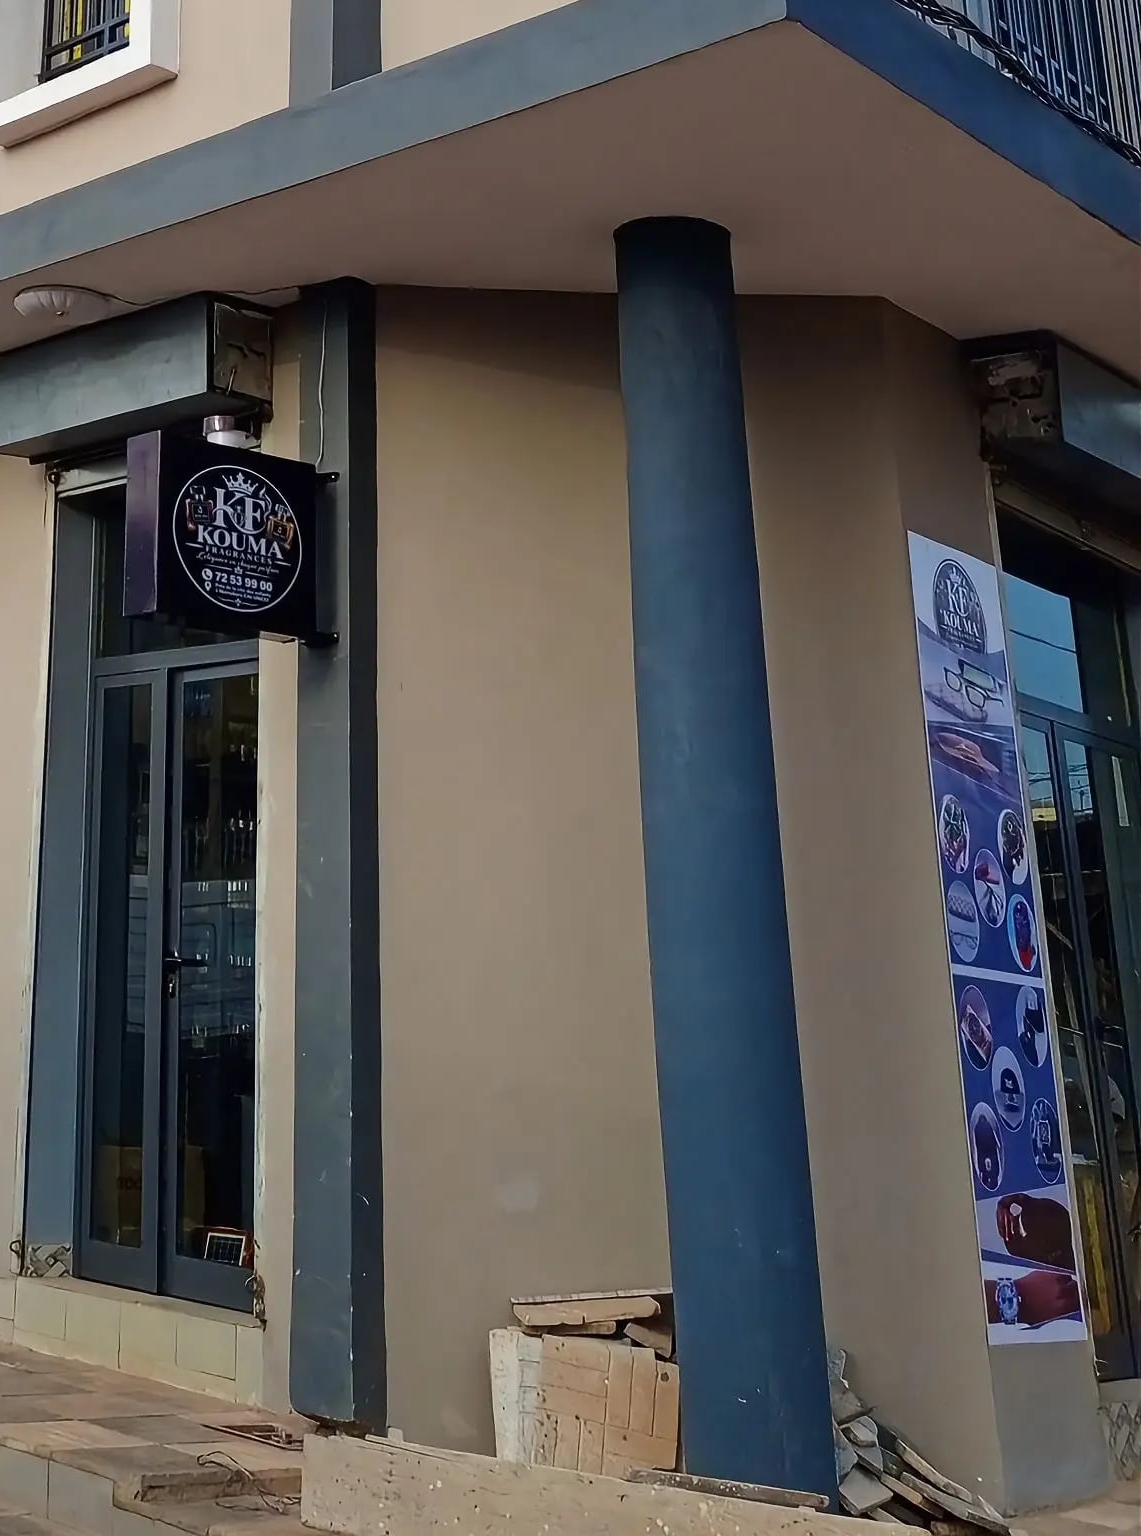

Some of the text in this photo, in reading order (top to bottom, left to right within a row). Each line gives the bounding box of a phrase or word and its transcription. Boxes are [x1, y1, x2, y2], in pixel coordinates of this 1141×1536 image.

[212, 486, 267, 534] KF
[197, 524, 284, 560] KOUMA
[205, 544, 273, 565] FRAGRANCES
[215, 571, 273, 592] 72 53 99 00
